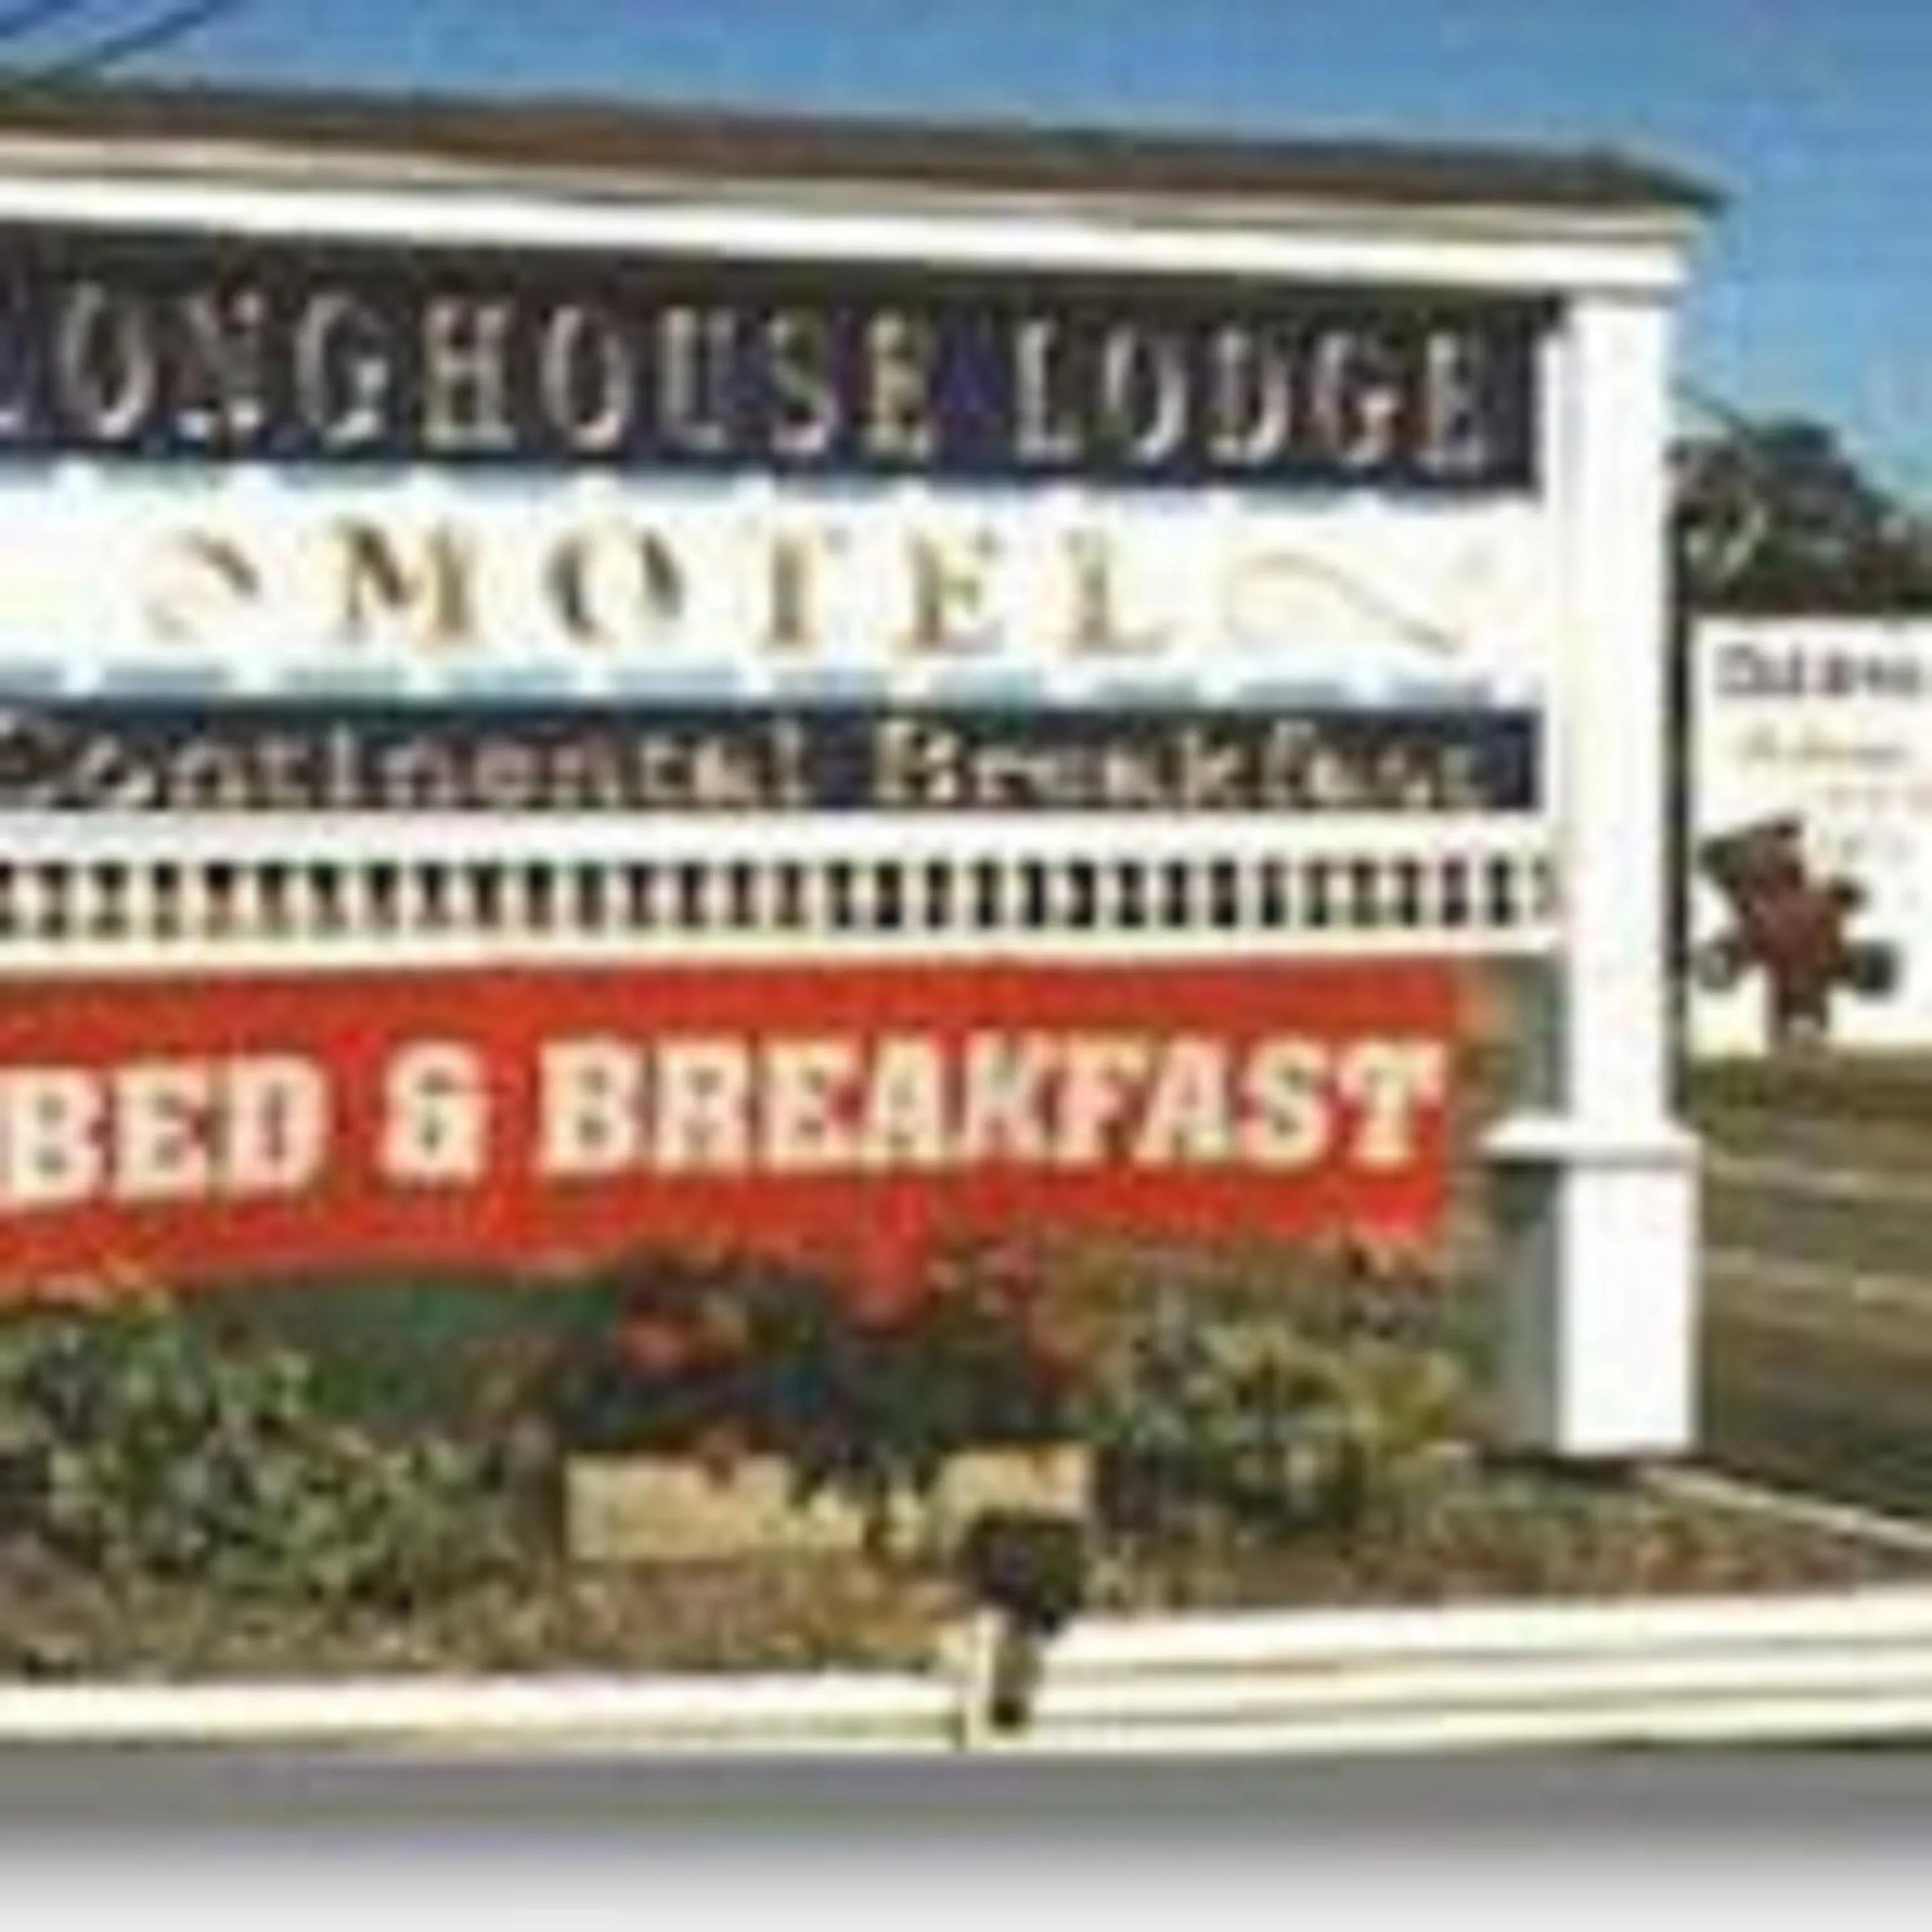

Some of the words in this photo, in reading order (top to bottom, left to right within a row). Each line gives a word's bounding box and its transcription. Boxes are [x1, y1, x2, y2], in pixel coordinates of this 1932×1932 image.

[1010, 317, 1487, 468] LODGE
[327, 514, 1171, 656] MOTEL
[3, 1055, 327, 1205] BED
[379, 1038, 487, 1187] &
[537, 1026, 1446, 1179] BREAKFAST
